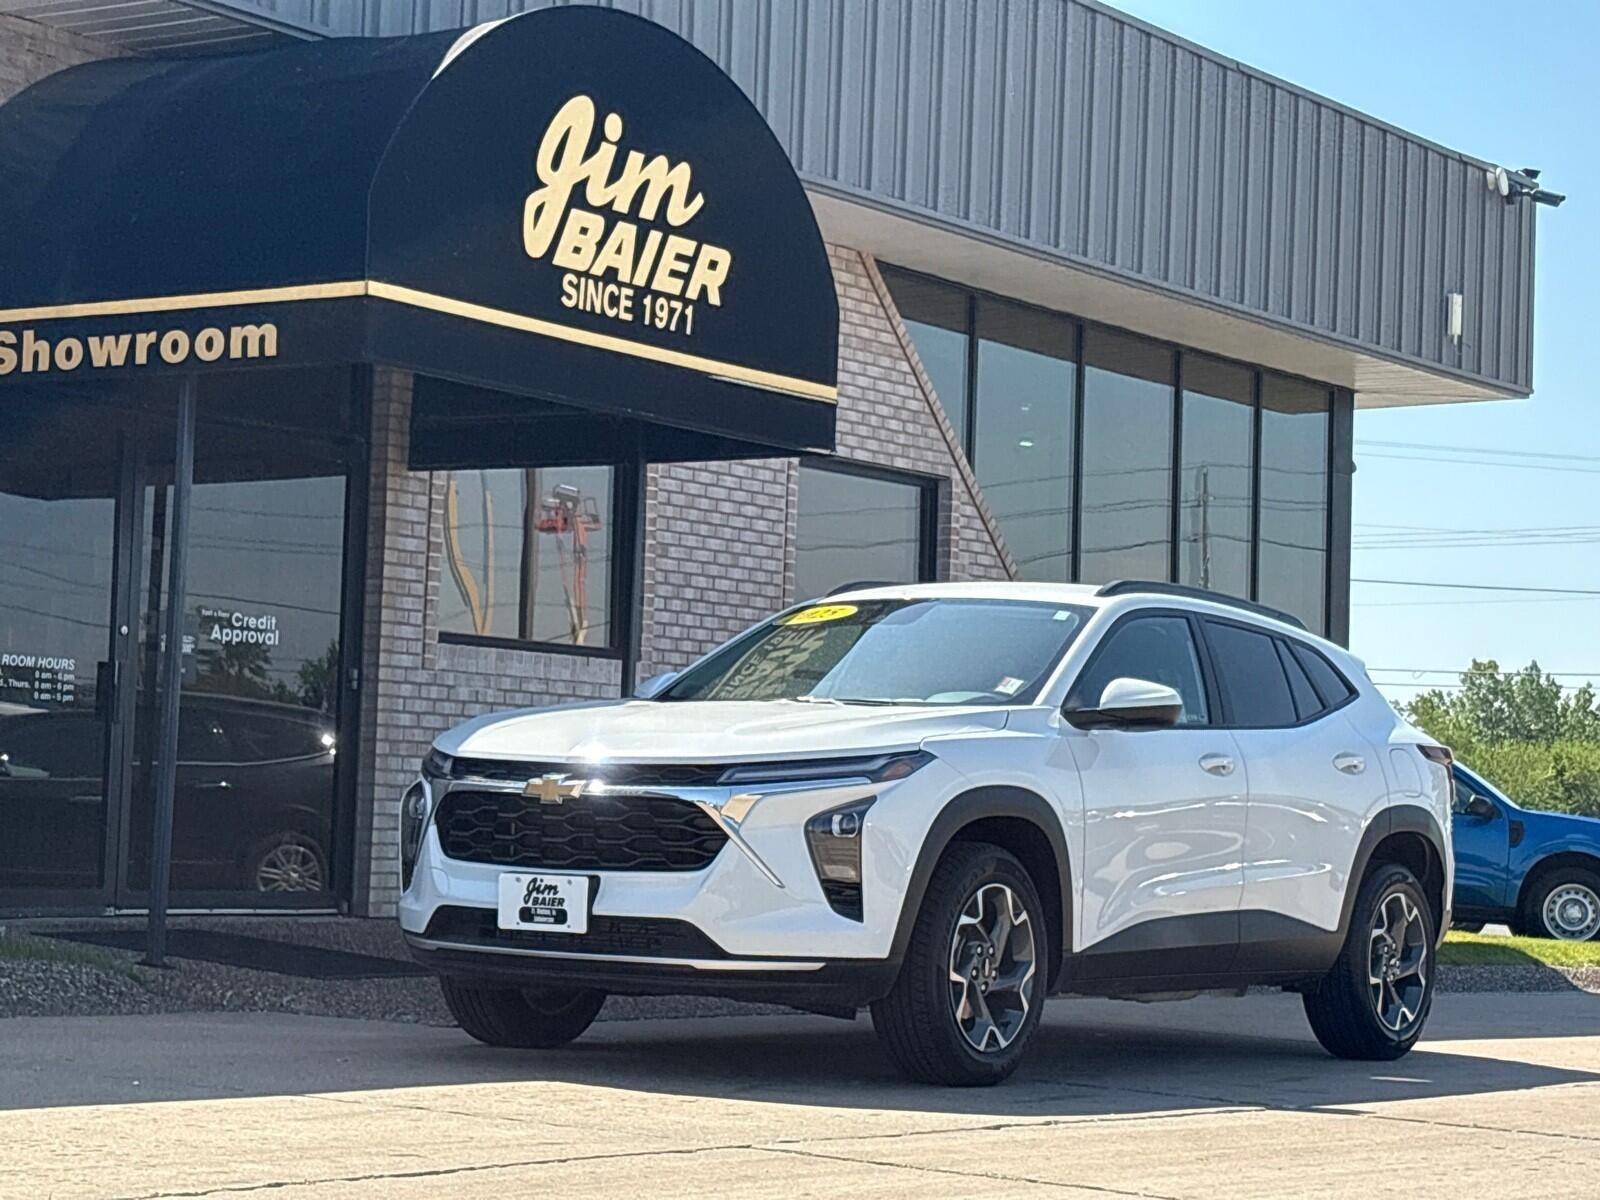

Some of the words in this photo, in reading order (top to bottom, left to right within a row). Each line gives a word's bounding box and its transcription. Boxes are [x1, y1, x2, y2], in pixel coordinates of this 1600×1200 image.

[523, 95, 705, 259] Jim
[552, 208, 732, 307] BAIER
[561, 273, 635, 322] SINCE
[643, 294, 694, 336] 1971
[0, 322, 278, 376] Showroom
[232, 612, 277, 630] Credit
[210, 623, 279, 646] Approval
[2, 654, 36, 668] ROOM
[37, 657, 76, 670] HOURS
[8, 678, 31, 689] Thurs.
[523, 877, 559, 906] Jim
[531, 896, 565, 907] BAIER
